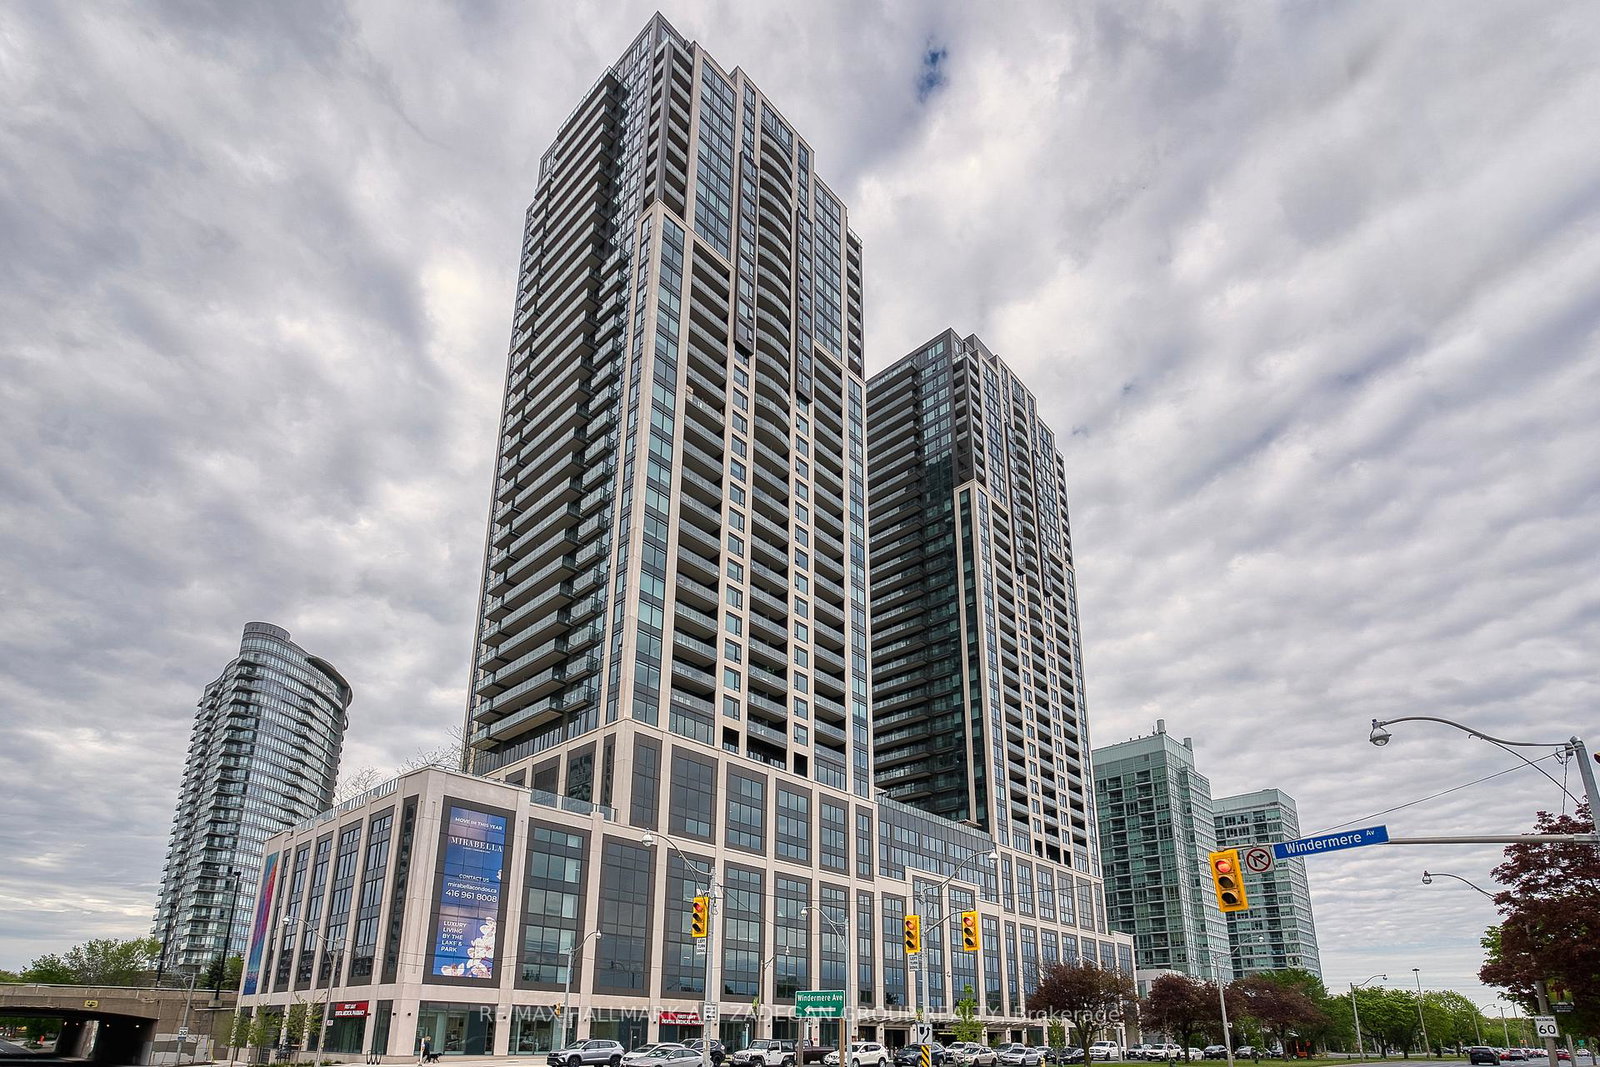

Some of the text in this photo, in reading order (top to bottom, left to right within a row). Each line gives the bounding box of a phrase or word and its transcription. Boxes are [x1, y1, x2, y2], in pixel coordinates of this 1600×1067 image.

[451, 836, 503, 852] MIRABELLA
[1285, 829, 1375, 854] Windermere Av
[458, 873, 482, 881] CONTACT
[447, 882, 497, 893] mirabellacondos.ca
[445, 889, 498, 902] 416 961 8008
[443, 920, 467, 928] LUXURY
[797, 993, 843, 1002] Windermere Ave
[1539, 1024, 1556, 1035] 60
